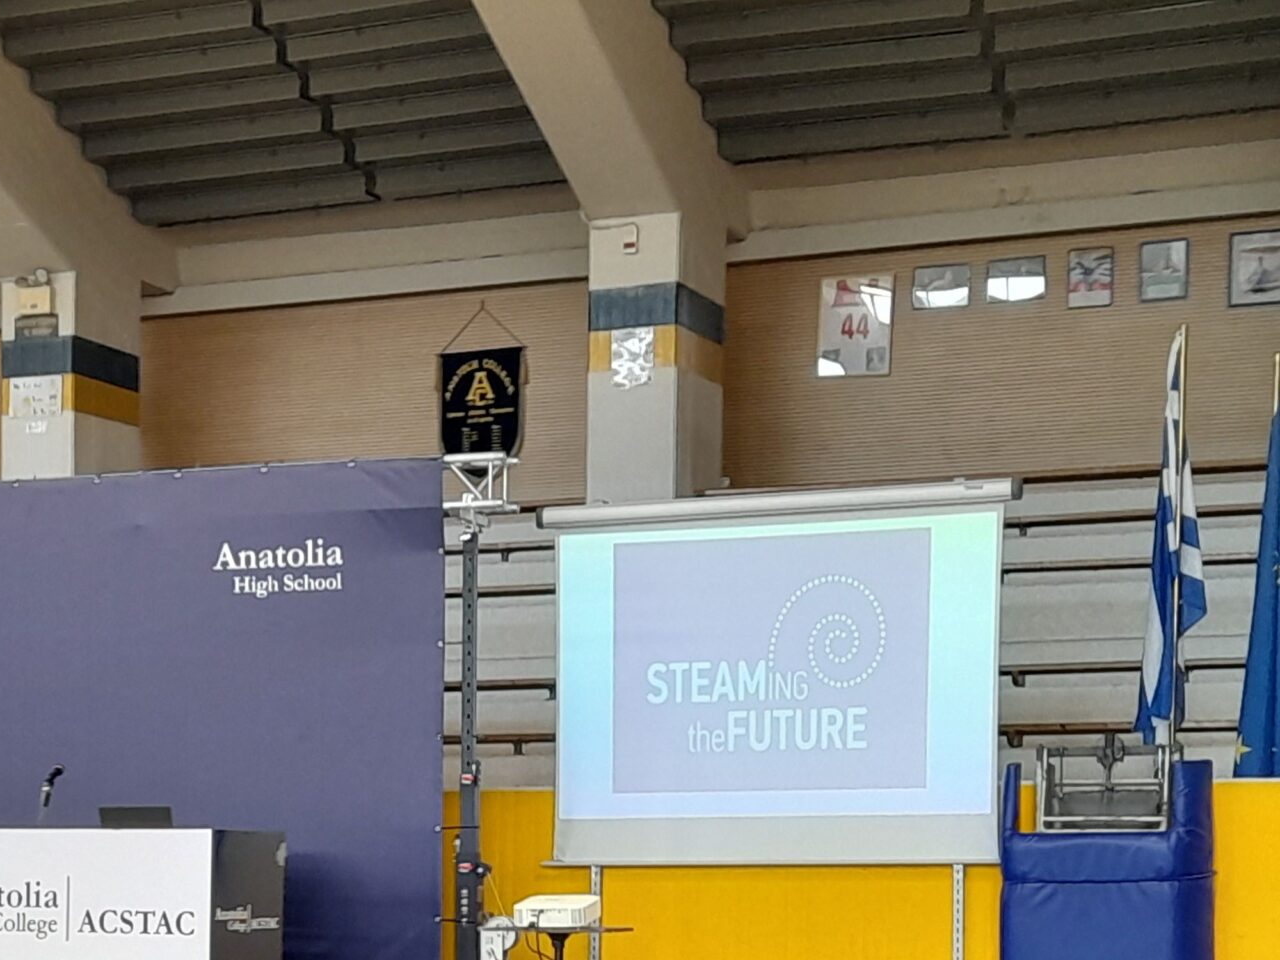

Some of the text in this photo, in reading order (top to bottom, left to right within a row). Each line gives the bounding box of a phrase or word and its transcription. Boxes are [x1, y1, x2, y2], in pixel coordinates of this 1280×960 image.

[841, 313, 869, 339] 44
[212, 538, 343, 570] Anatolia
[233, 572, 342, 598] High School
[77, 910, 195, 936] ACSTAC
